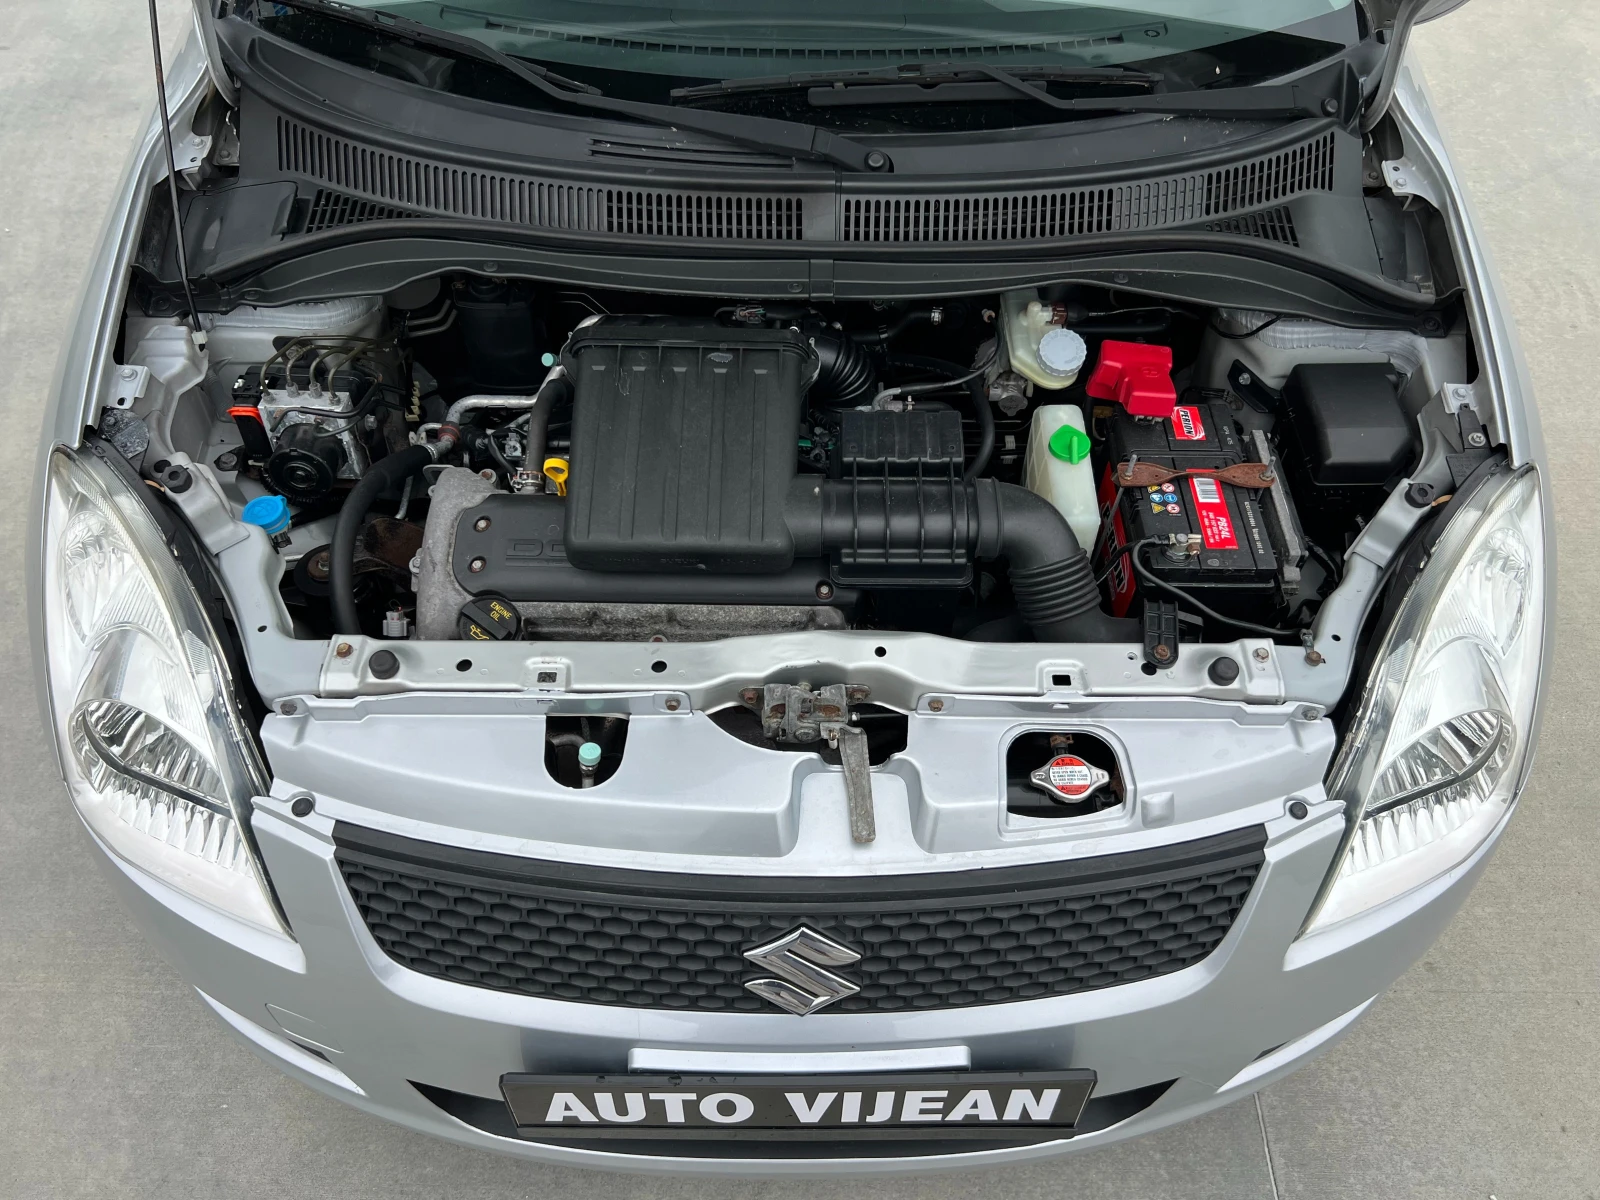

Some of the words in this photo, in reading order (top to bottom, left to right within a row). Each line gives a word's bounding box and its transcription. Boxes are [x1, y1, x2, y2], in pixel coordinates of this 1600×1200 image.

[1179, 409, 1194, 435] PERION
[1216, 516, 1231, 539] PB24L
[490, 601, 512, 620] ENGINE
[490, 610, 500, 621] OIL
[545, 1092, 755, 1124] AUTO
[784, 1088, 1062, 1122] VIJEAN
